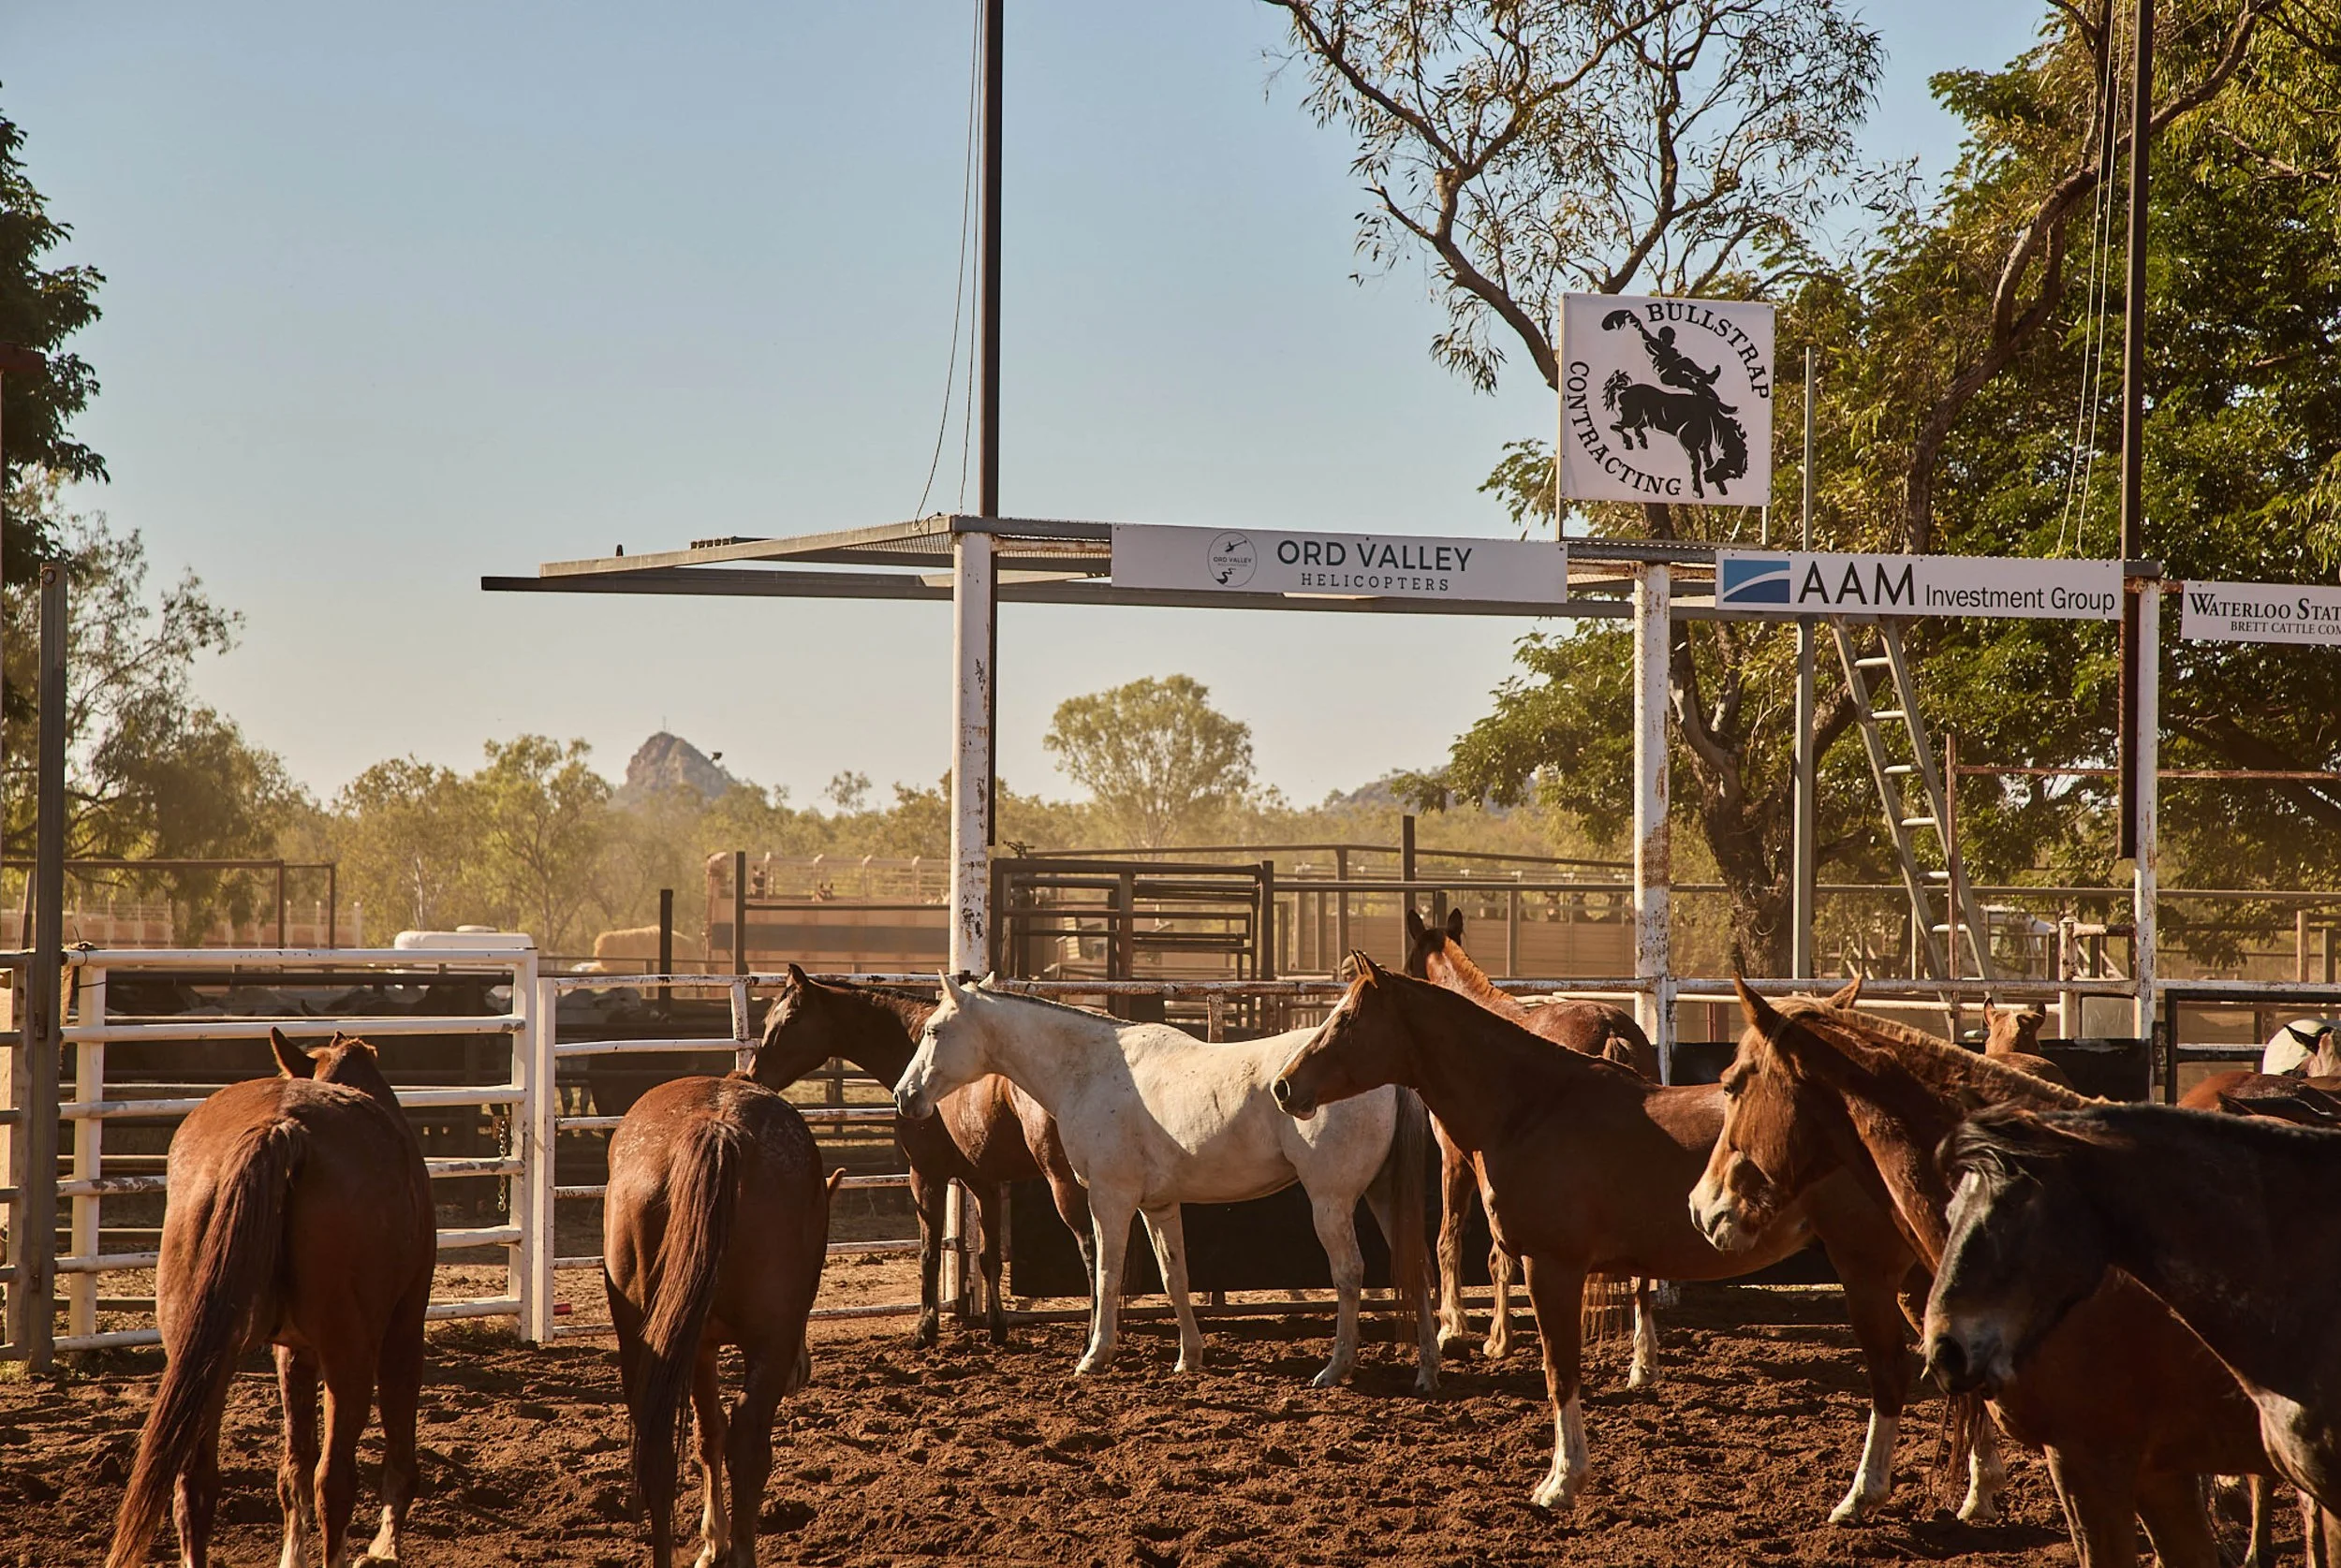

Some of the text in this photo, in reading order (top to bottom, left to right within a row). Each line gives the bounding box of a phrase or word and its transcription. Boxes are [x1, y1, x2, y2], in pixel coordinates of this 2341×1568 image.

[1645, 302, 1770, 399] BULLSTRAP
[1567, 360, 1682, 496] CONTRACTING
[1277, 539, 1473, 572] ORD VALLEY
[1302, 573, 1449, 592] HELICOPTERS
[1797, 560, 2115, 614] AAM Investment Group
[2188, 593, 2291, 619] WATERLOO
[2231, 621, 2268, 633] BRETT
[2271, 623, 2316, 635] CATTLE
